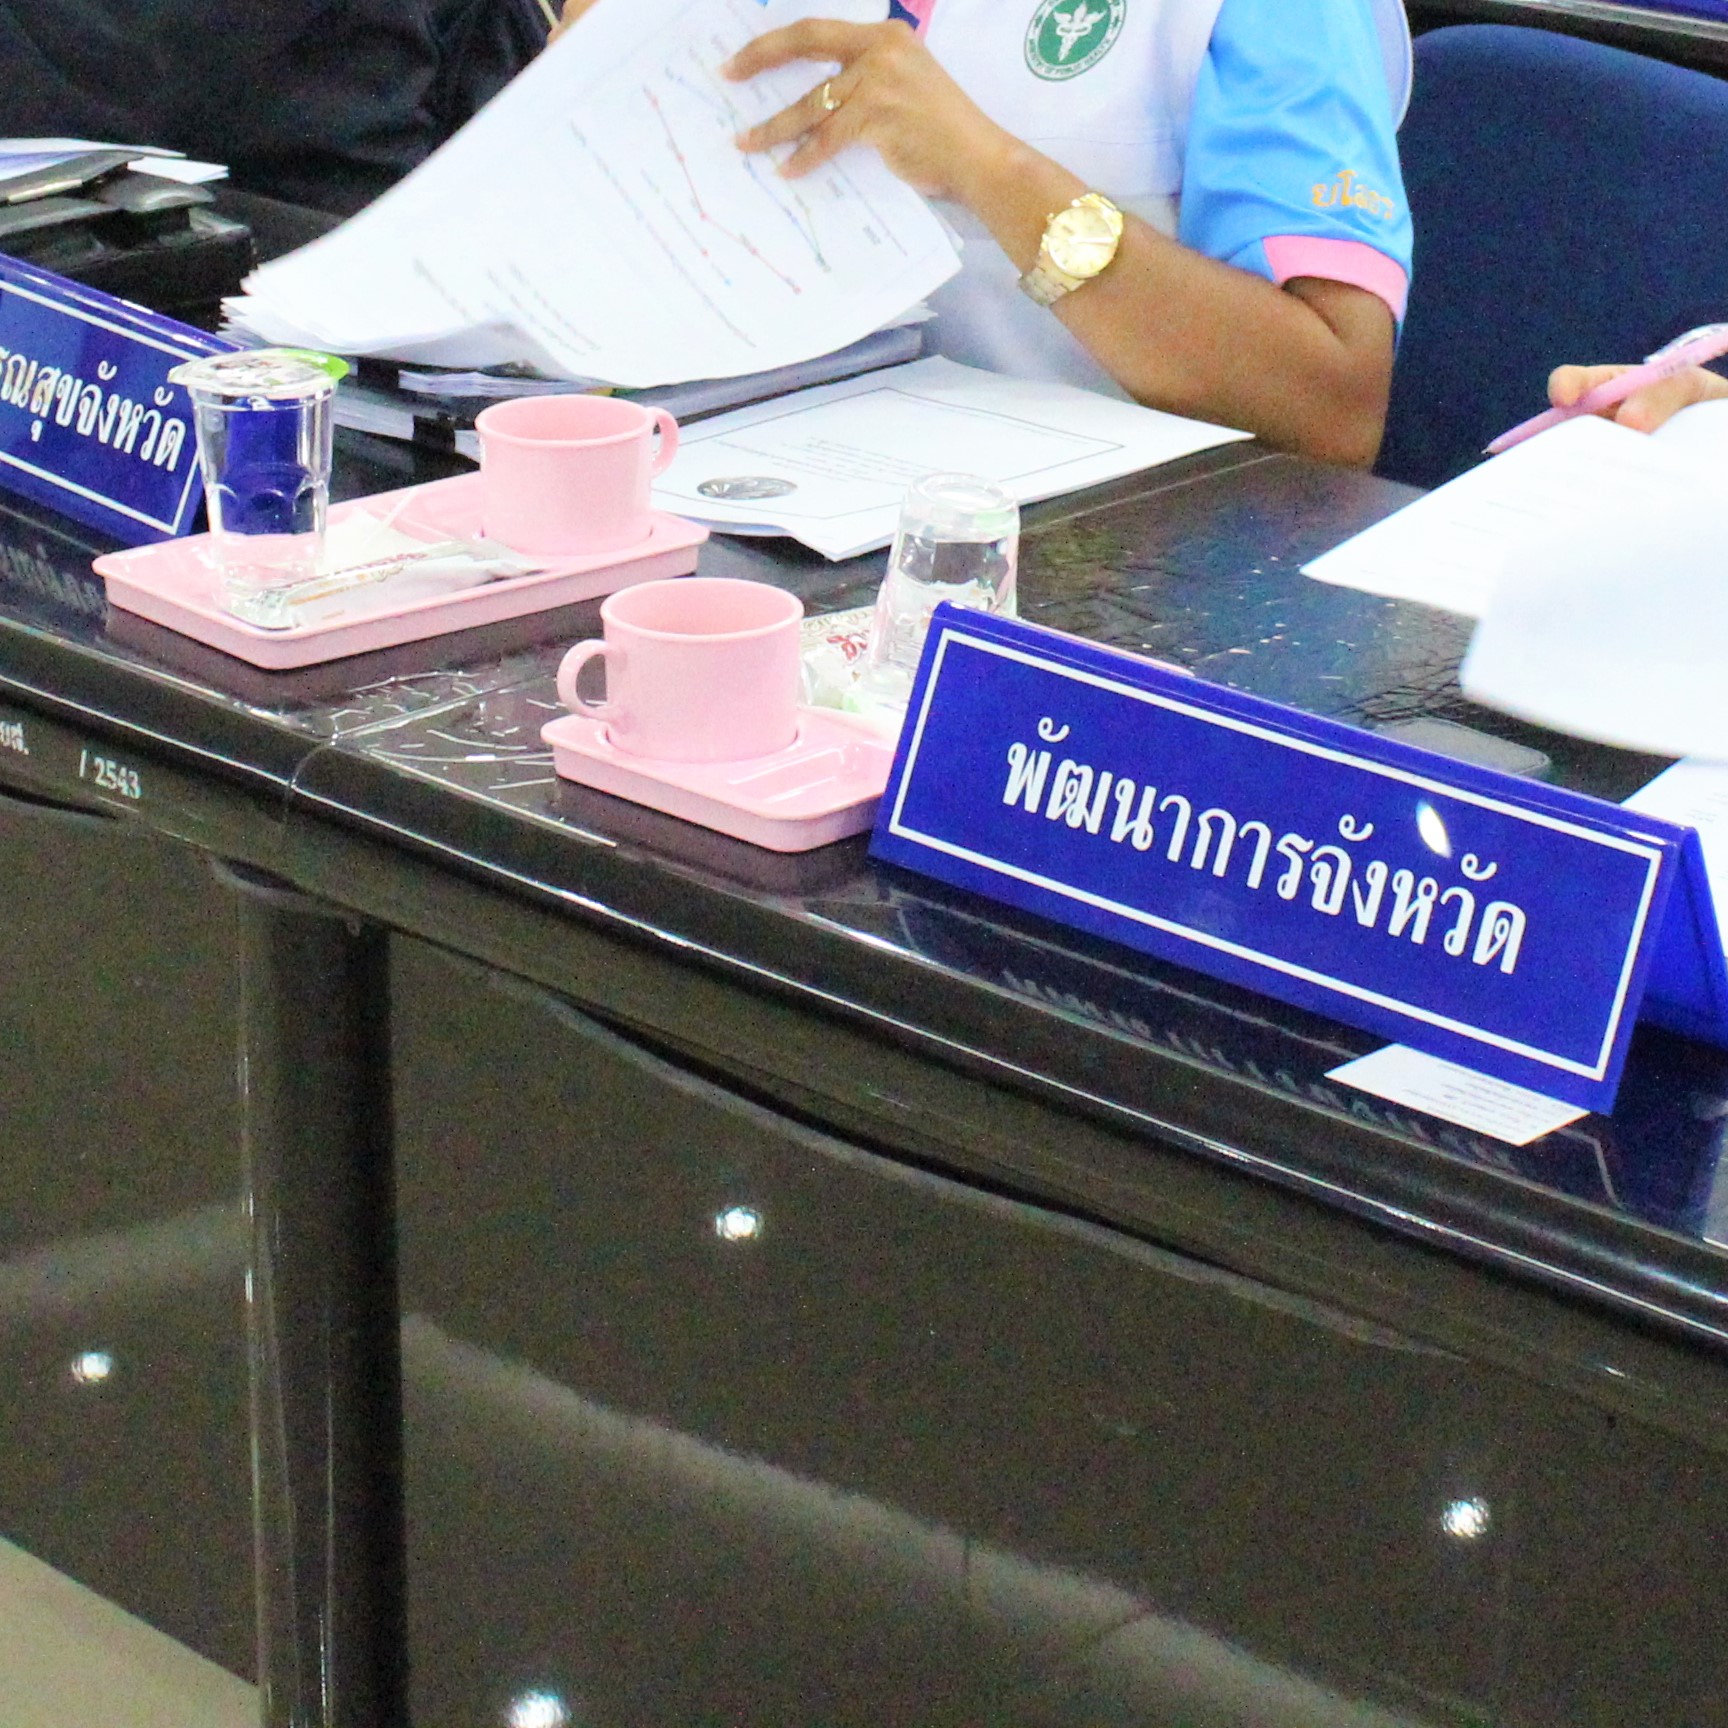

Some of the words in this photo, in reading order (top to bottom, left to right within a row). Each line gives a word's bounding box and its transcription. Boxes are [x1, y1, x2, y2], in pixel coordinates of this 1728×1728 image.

[93, 756, 142, 800] 2543
[1001, 716, 1528, 975] พัฒนาการจังหวัด
